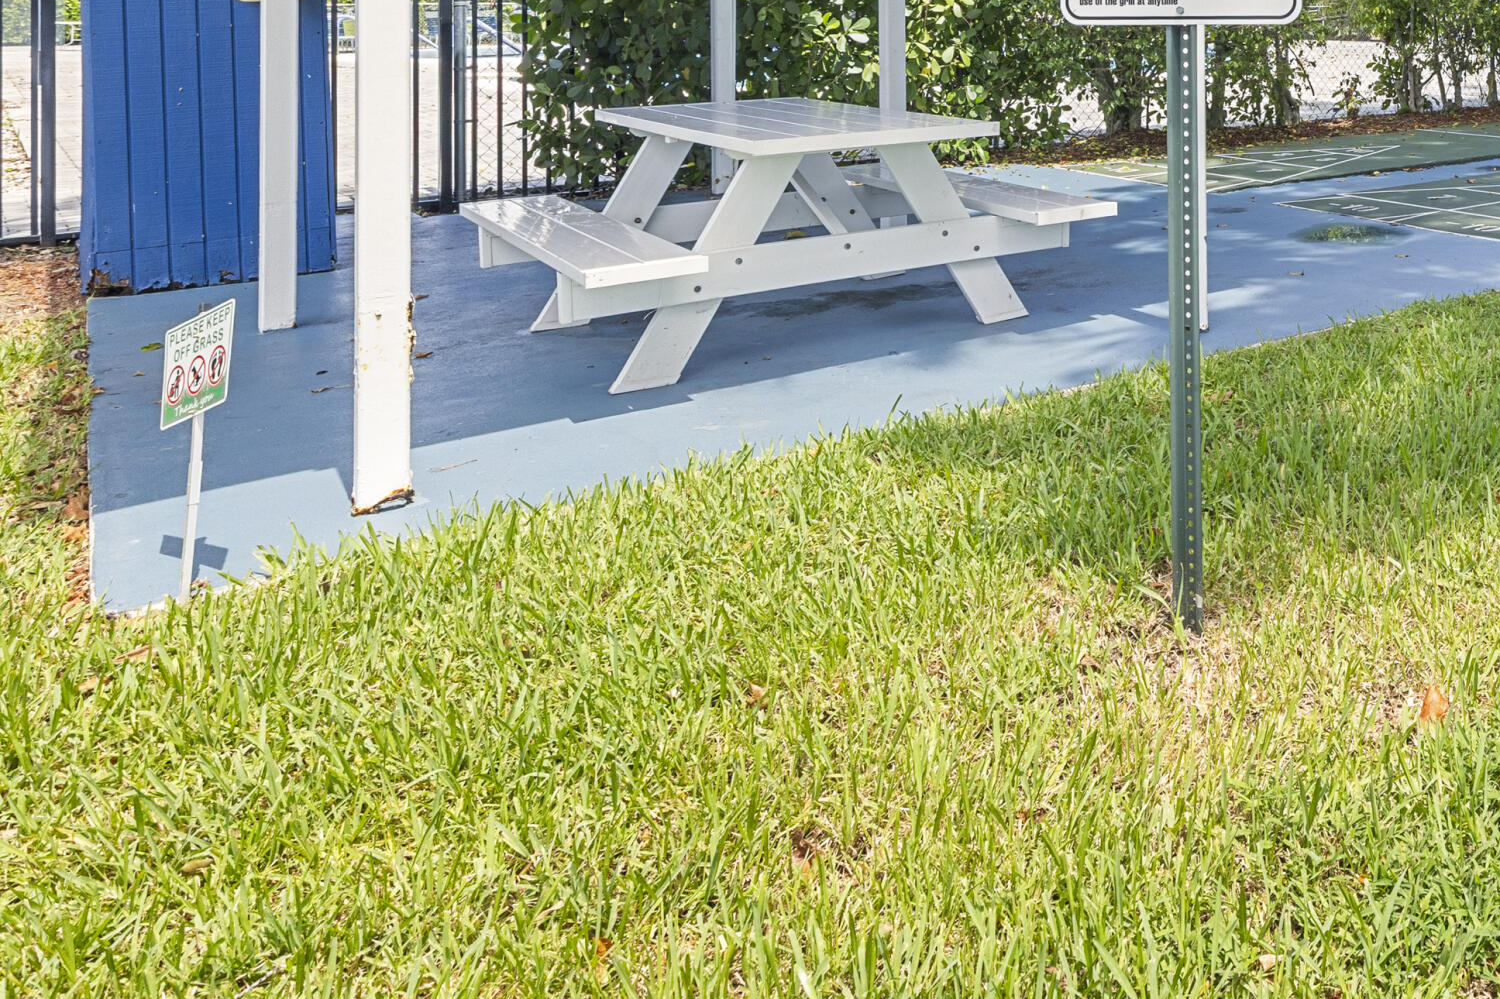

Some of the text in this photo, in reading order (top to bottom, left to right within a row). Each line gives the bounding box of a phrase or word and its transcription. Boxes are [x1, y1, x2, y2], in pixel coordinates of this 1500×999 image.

[169, 306, 231, 348] PLEASE KEEP
[173, 327, 224, 362] OFF GRASS
